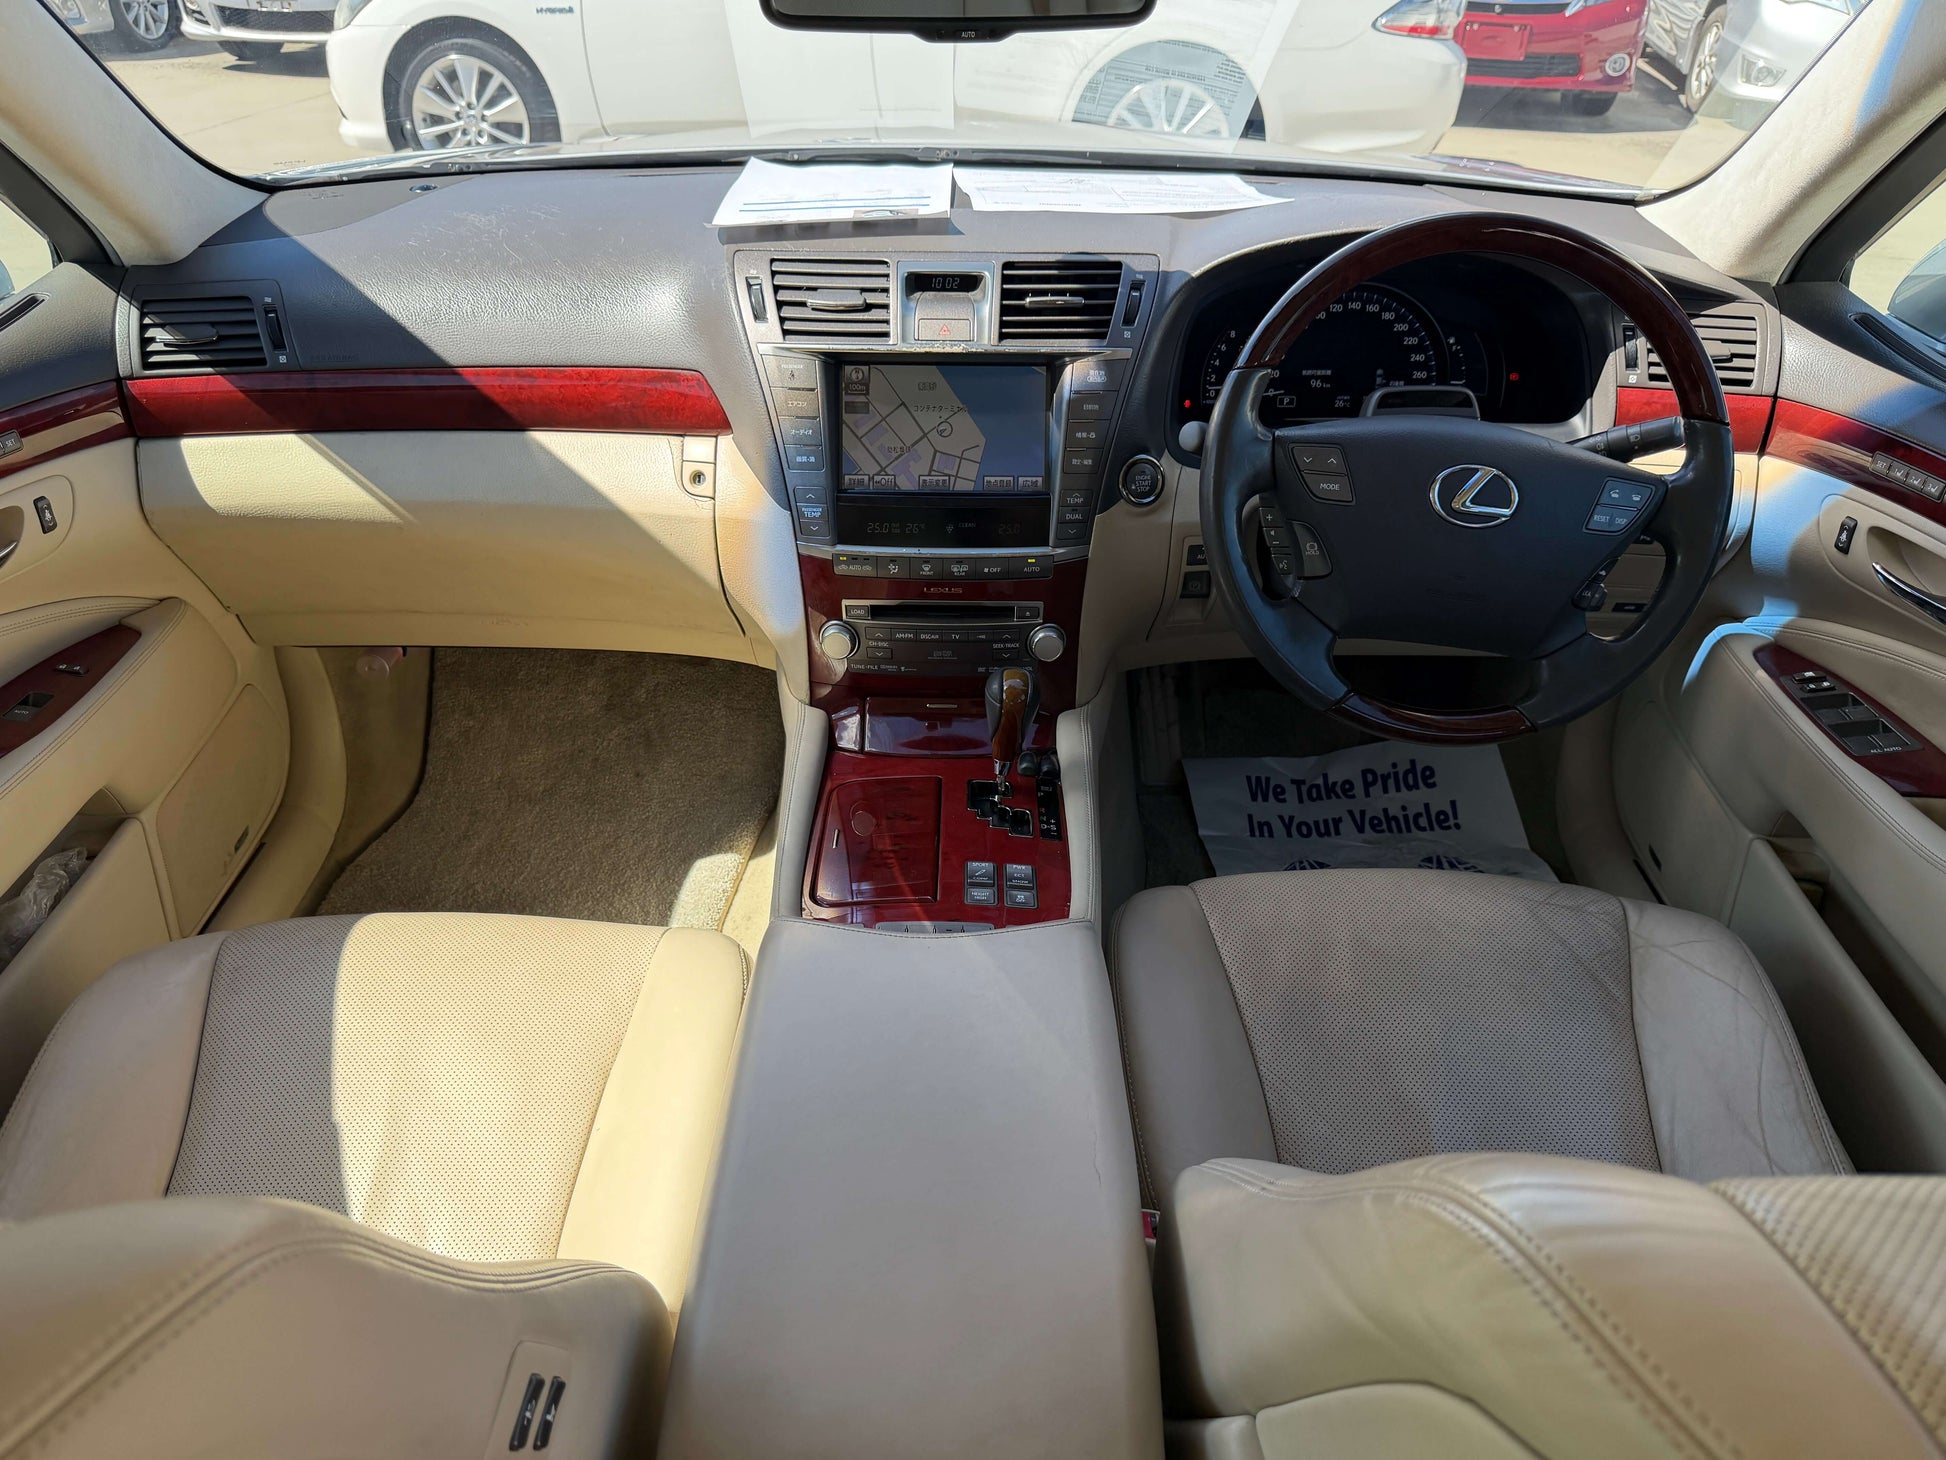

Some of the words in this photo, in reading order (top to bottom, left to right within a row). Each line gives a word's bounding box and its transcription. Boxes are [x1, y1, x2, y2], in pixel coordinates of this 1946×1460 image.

[1329, 303, 1343, 312] 120
[1348, 301, 1361, 310] 140
[1366, 303, 1380, 312] 160
[1381, 311, 1395, 320] 180
[1393, 323, 1409, 331] 200
[1230, 330, 1236, 338] 8
[1403, 336, 1418, 345] 220
[1221, 343, 1227, 351] 6
[1410, 353, 1425, 362] 240
[1210, 374, 1216, 382] 2
[1412, 370, 1428, 379] 260
[1310, 378, 1322, 388] 96
[1209, 389, 1216, 398] 0
[1283, 397, 1290, 406] P
[5, 438, 17, 447] SET
[1876, 460, 1886, 469] SET
[1320, 483, 1340, 491] MODE
[1593, 514, 1610, 522] RESET
[1615, 517, 1627, 525] DISP
[866, 523, 890, 533] 25.0
[1884, 745, 1902, 753] AUTO
[1246, 775, 1287, 804] We
[1290, 772, 1356, 805] Take
[1360, 758, 1437, 799] Pride
[1247, 813, 1274, 839] In
[1277, 814, 1343, 839] Your
[1347, 799, 1462, 835] Vehicle!
